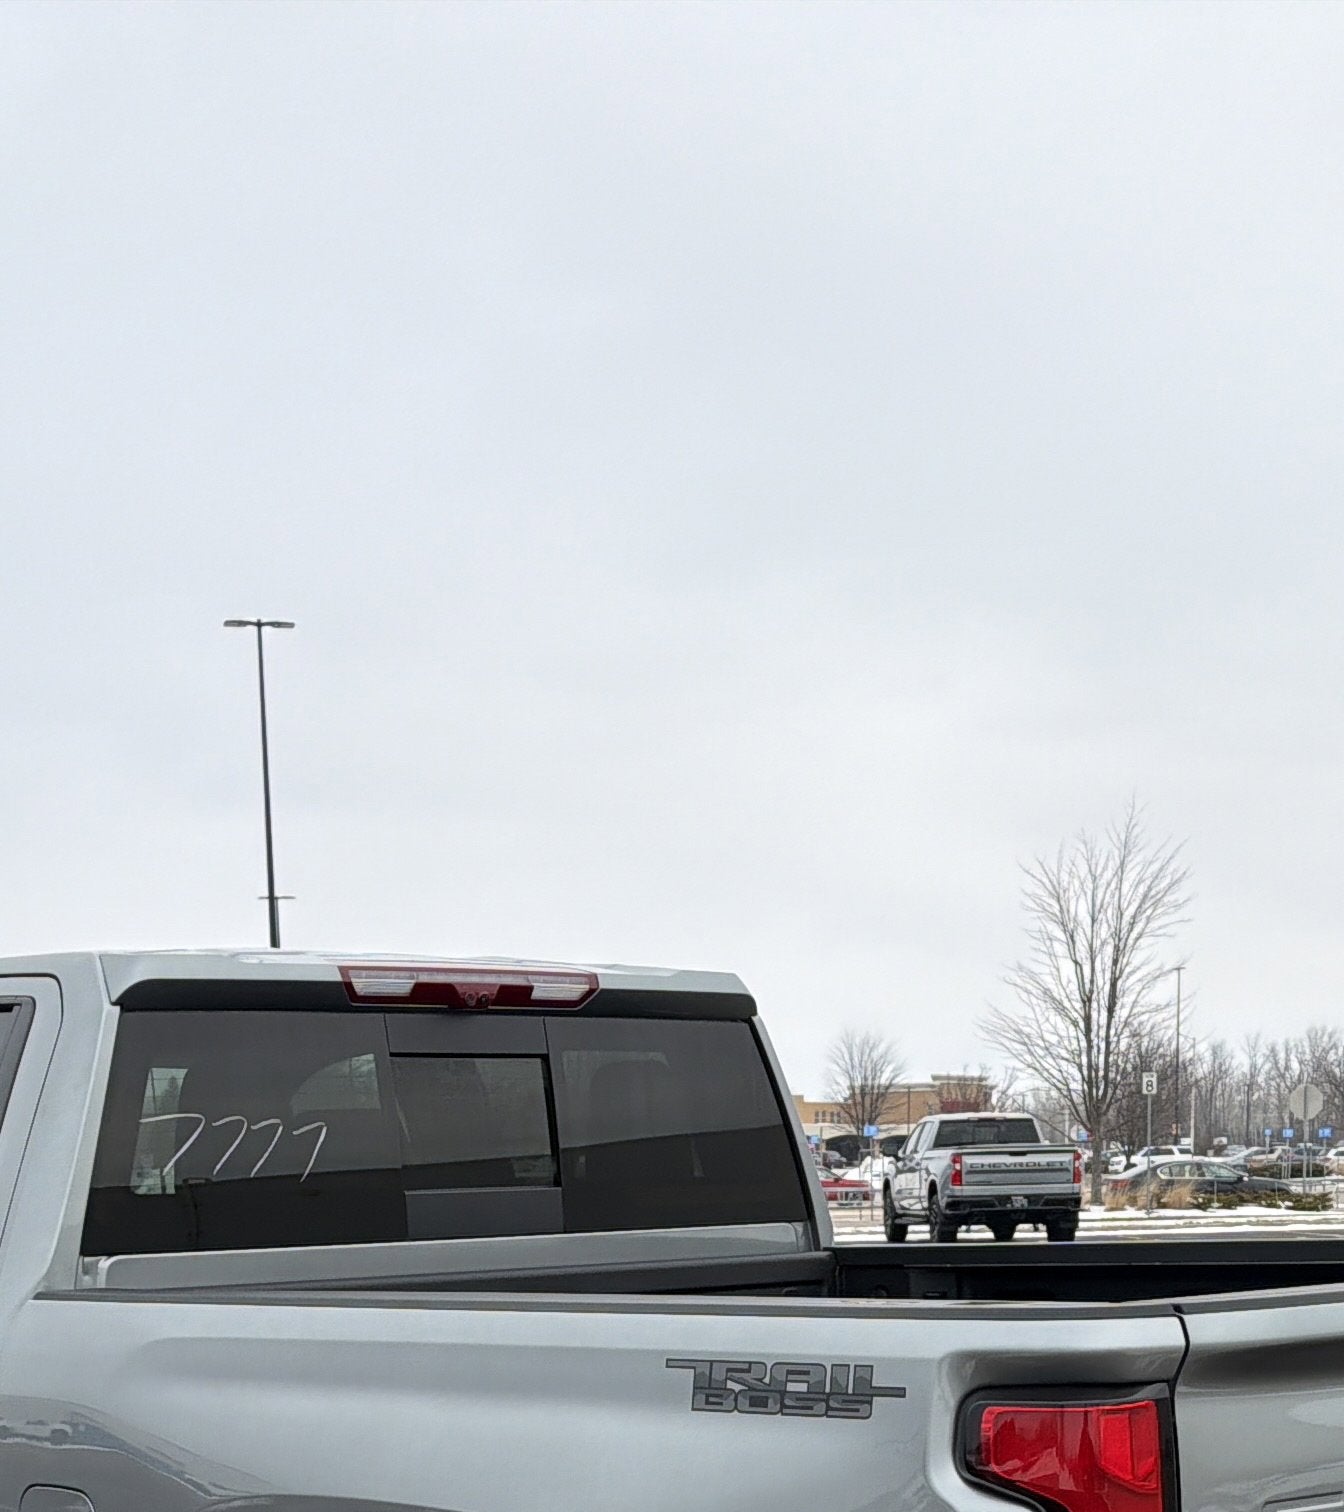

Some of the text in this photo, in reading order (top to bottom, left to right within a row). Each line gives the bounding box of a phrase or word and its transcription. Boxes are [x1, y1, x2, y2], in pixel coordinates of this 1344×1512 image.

[1145, 1080, 1154, 1093] 8
[969, 1160, 1067, 1169] CHEVROLET
[665, 1358, 906, 1398] TRAIL
[691, 1387, 873, 1420] BOSS
